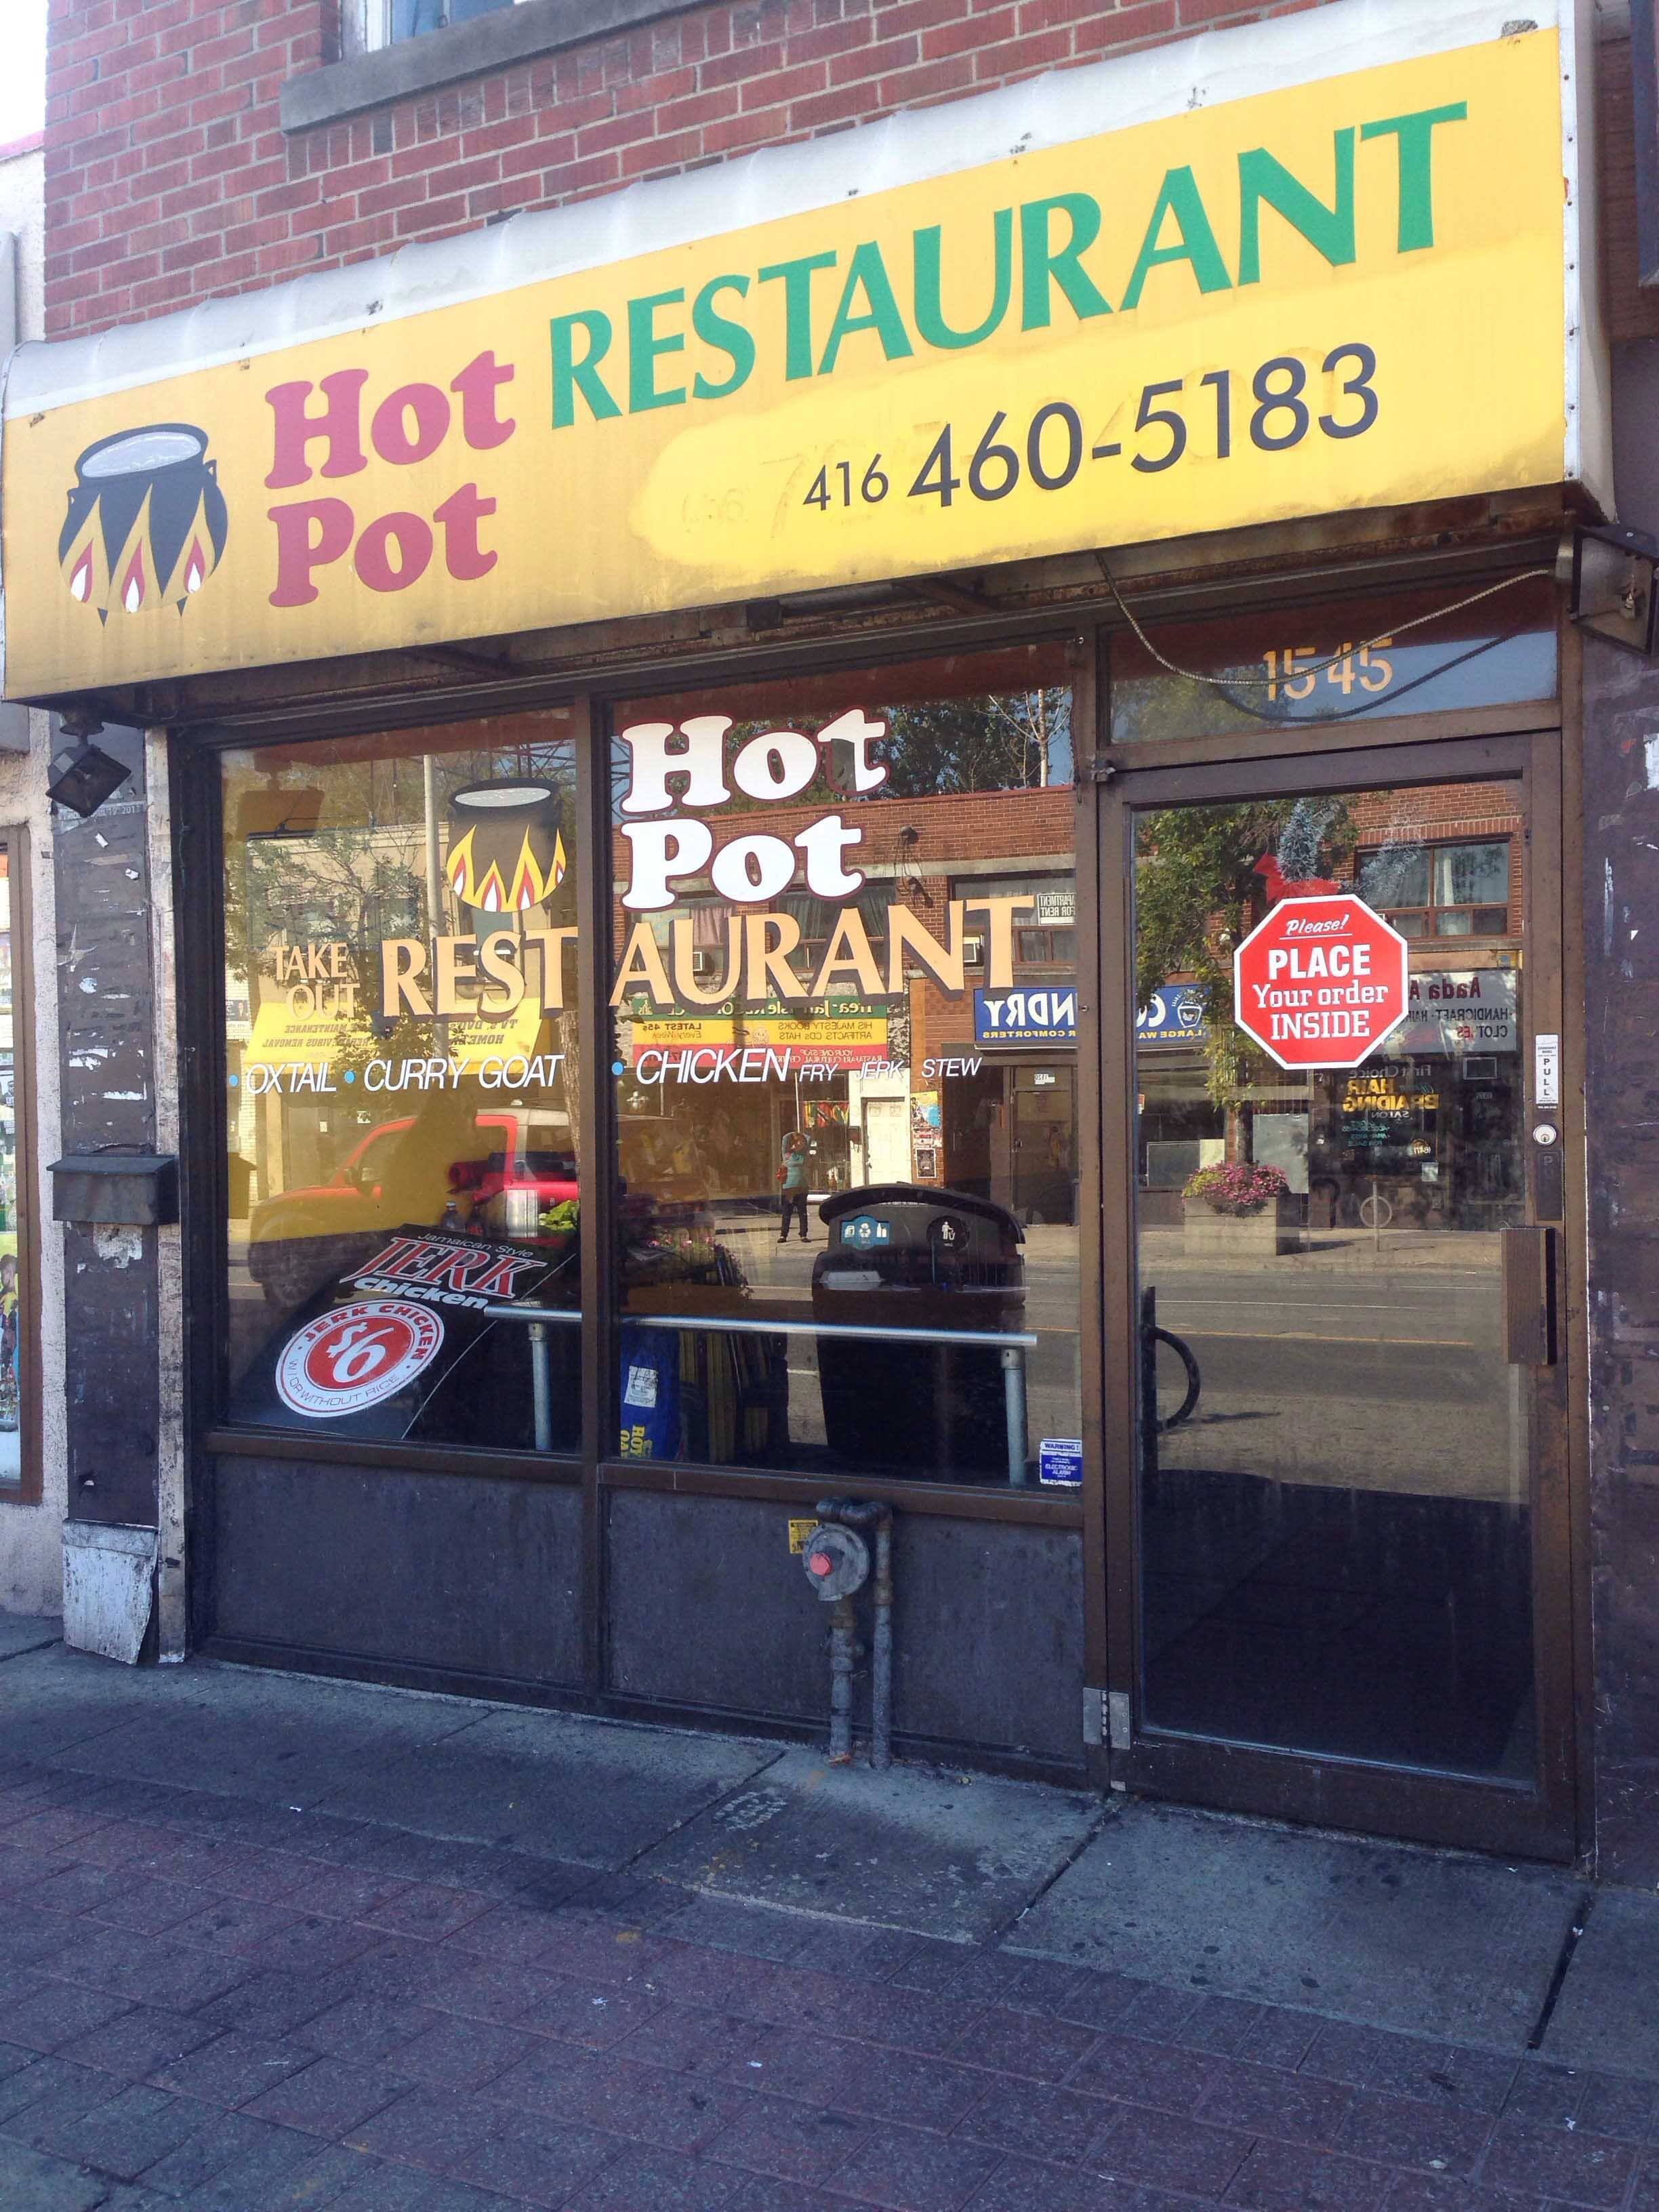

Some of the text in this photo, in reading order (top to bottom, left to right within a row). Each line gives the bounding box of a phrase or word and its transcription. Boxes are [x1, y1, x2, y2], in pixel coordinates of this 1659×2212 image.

[550, 100, 1467, 430] RESTAURANT
[264, 349, 516, 489] Hot
[802, 342, 1379, 511] 416 460-5183
[267, 483, 498, 608] Pot
[1263, 638, 1393, 701] 1545
[620, 708, 889, 815] Hot
[619, 814, 866, 912] Pot
[1286, 914, 1350, 935] Please!
[273, 941, 348, 981] TAKE
[1268, 943, 1371, 981] PLACE
[287, 982, 361, 1020] OUT
[1252, 979, 1389, 1009] Your order
[1270, 1010, 1370, 1040] INSIDE
[245, 1054, 565, 1094] OXTAIL CURRY GOAT
[636, 1047, 792, 1085] CHICKEN
[799, 1063, 839, 1083] FRY
[856, 1061, 906, 1080] JERK
[921, 1057, 982, 1079] STEW
[1542, 1058, 1551, 1096] PULL
[417, 1233, 534, 1258] Jamaican Style
[339, 1236, 548, 1298] JERK
[304, 1304, 435, 1361] JERK CHICKEN
[325, 1322, 394, 1383] $6
[301, 1391, 363, 1406] WITHOUT
[365, 1375, 401, 1397] RICE
